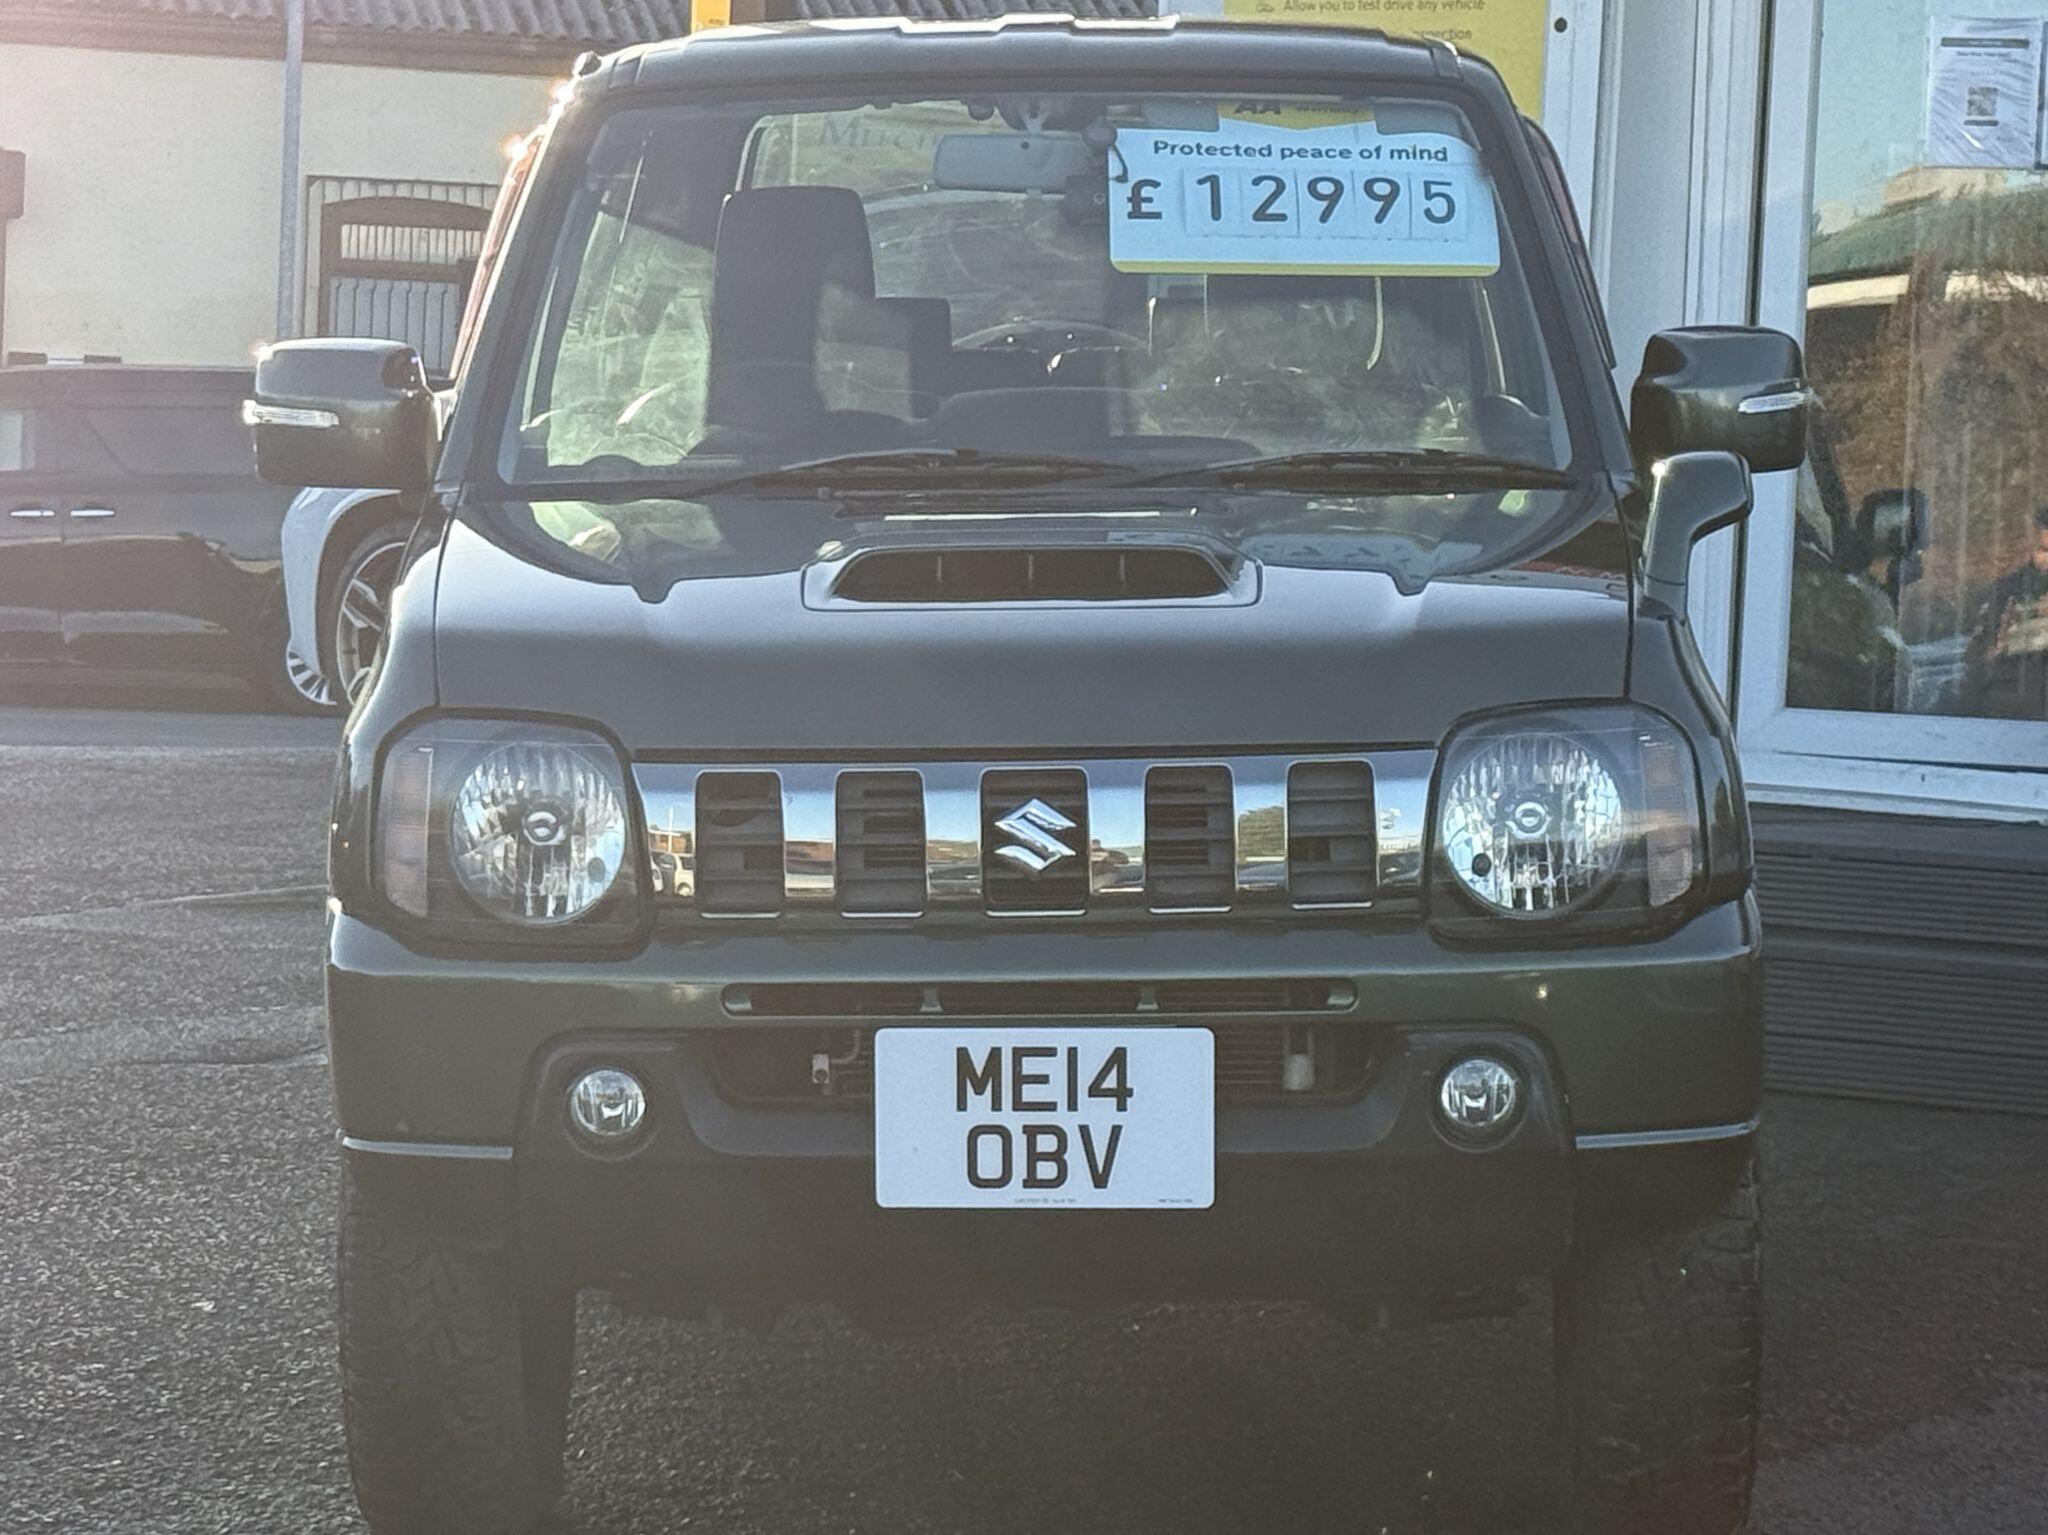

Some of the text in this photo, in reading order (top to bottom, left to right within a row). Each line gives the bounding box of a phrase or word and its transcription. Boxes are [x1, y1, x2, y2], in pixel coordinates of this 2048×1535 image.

[1284, 0, 1486, 13] Allow you to test drive any vehicle
[1153, 139, 1448, 162] Protected peace of mind
[955, 1046, 1134, 1112] ME14
[966, 1124, 1123, 1189] OBV
